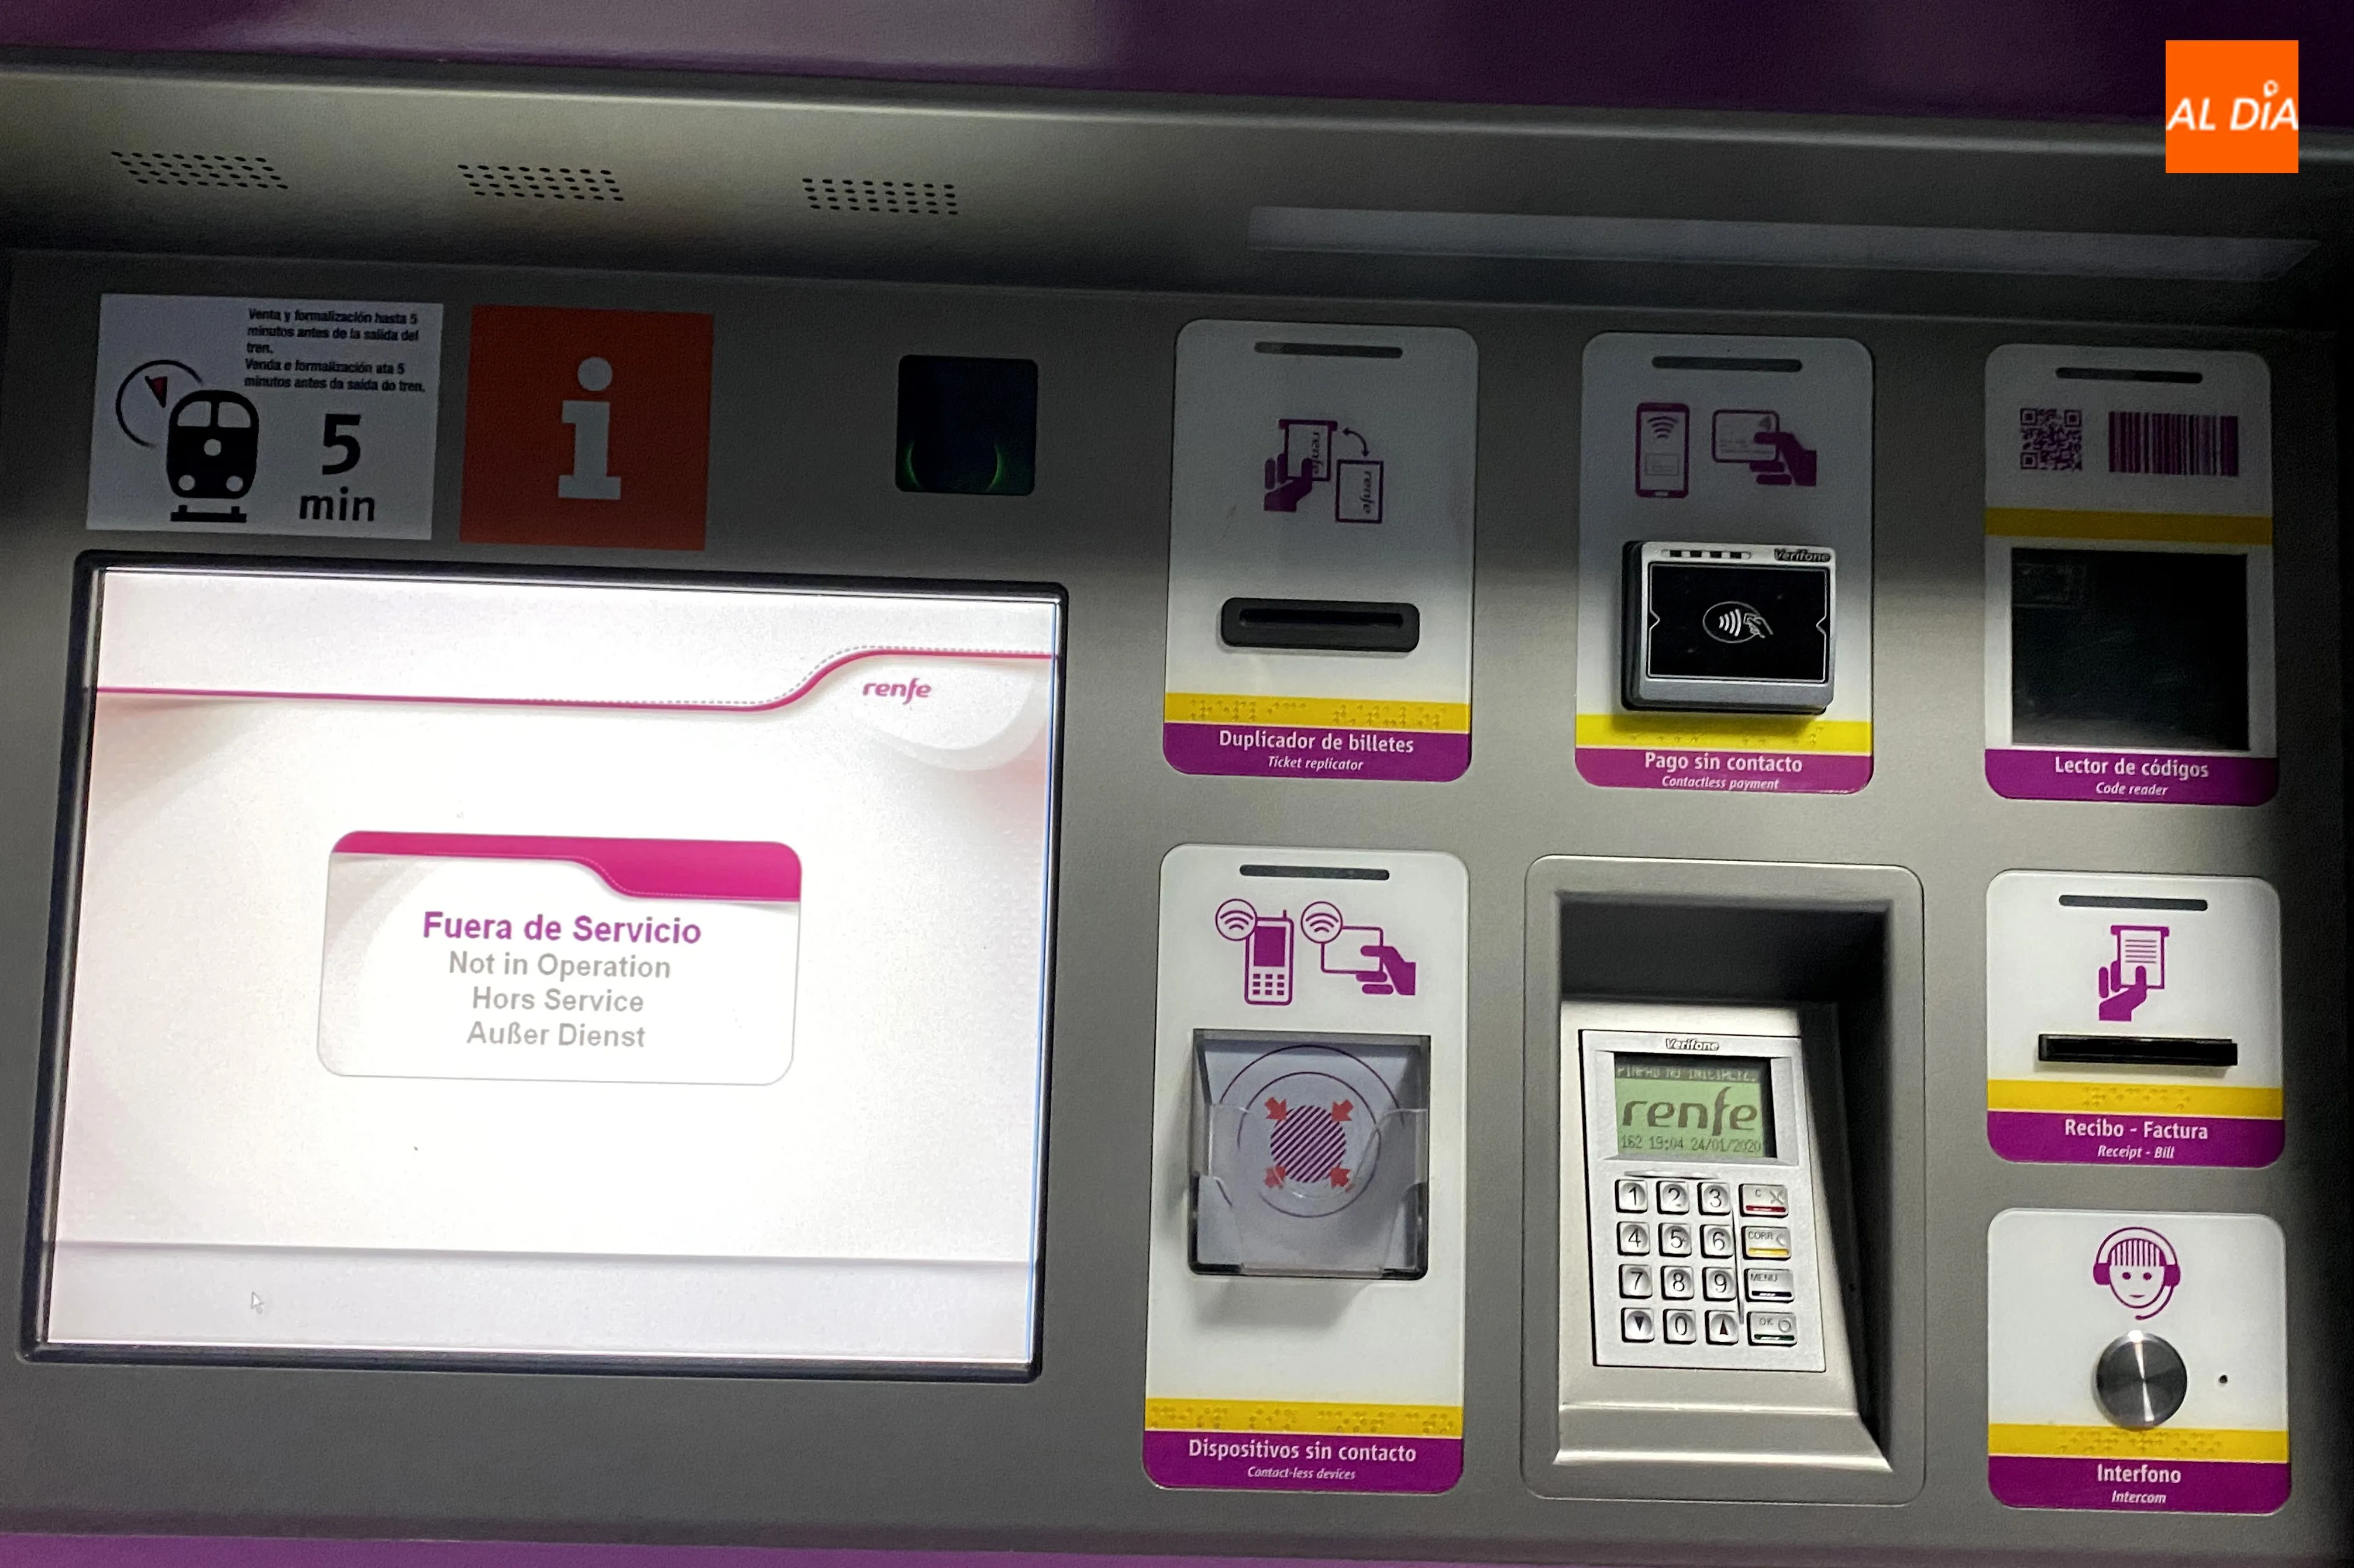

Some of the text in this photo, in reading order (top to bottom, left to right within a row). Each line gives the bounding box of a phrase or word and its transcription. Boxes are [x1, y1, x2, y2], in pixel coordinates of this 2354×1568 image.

[248, 308, 419, 325] Venta y formalización hasta 5
[247, 325, 419, 342] minutos antes de la salida del
[246, 342, 274, 354] tren.
[245, 358, 405, 375] Venda e formalización ata 5
[244, 375, 292, 389] minutos
[294, 377, 328, 390] antes
[329, 377, 344, 390] da
[381, 380, 397, 392] do
[399, 378, 426, 393] tren.
[322, 413, 362, 475] 5
[300, 486, 375, 522] min
[1774, 548, 1830, 562] Verifone
[862, 677, 932, 705] renfe
[1219, 730, 1414, 753] Duplicador de billetes
[1268, 756, 1365, 772] Ticket replicator
[1645, 752, 1803, 773] Pago sin contacto
[2054, 756, 2209, 781] Lector de códigos
[1661, 775, 1780, 791] Contactless payment
[2095, 781, 2169, 796] Code reader
[423, 911, 701, 945] Fuera de Servicio
[449, 951, 670, 982] Not in Operation
[472, 986, 644, 1013] Hors Service
[466, 1021, 645, 1047] Außer Dienst
[1666, 1038, 1719, 1052] Verifone
[1622, 1086, 1757, 1136] renfe
[2065, 1118, 2124, 1138] Recibo
[2143, 1121, 2208, 1139] Factura
[1650, 1136, 1684, 1150] 19:04
[1691, 1137, 1762, 1154] 24/01/2020
[2097, 1145, 2142, 1160] Receipt
[2154, 1146, 2176, 1159] Bill
[1629, 1186, 1722, 1208] 1 2 3
[1628, 1229, 1725, 1251] 4 5 6
[1630, 1271, 1727, 1293] 7 8 9
[1750, 1273, 1778, 1282] MENU
[1674, 1315, 1688, 1336] 0
[1759, 1317, 1774, 1326] OK
[1189, 1438, 1417, 1462] Dispositivos sin contacto
[1248, 1466, 1355, 1481] Contact-less devices
[2097, 1463, 2182, 1484] Interfono
[2111, 1490, 2167, 1505] Intercom
